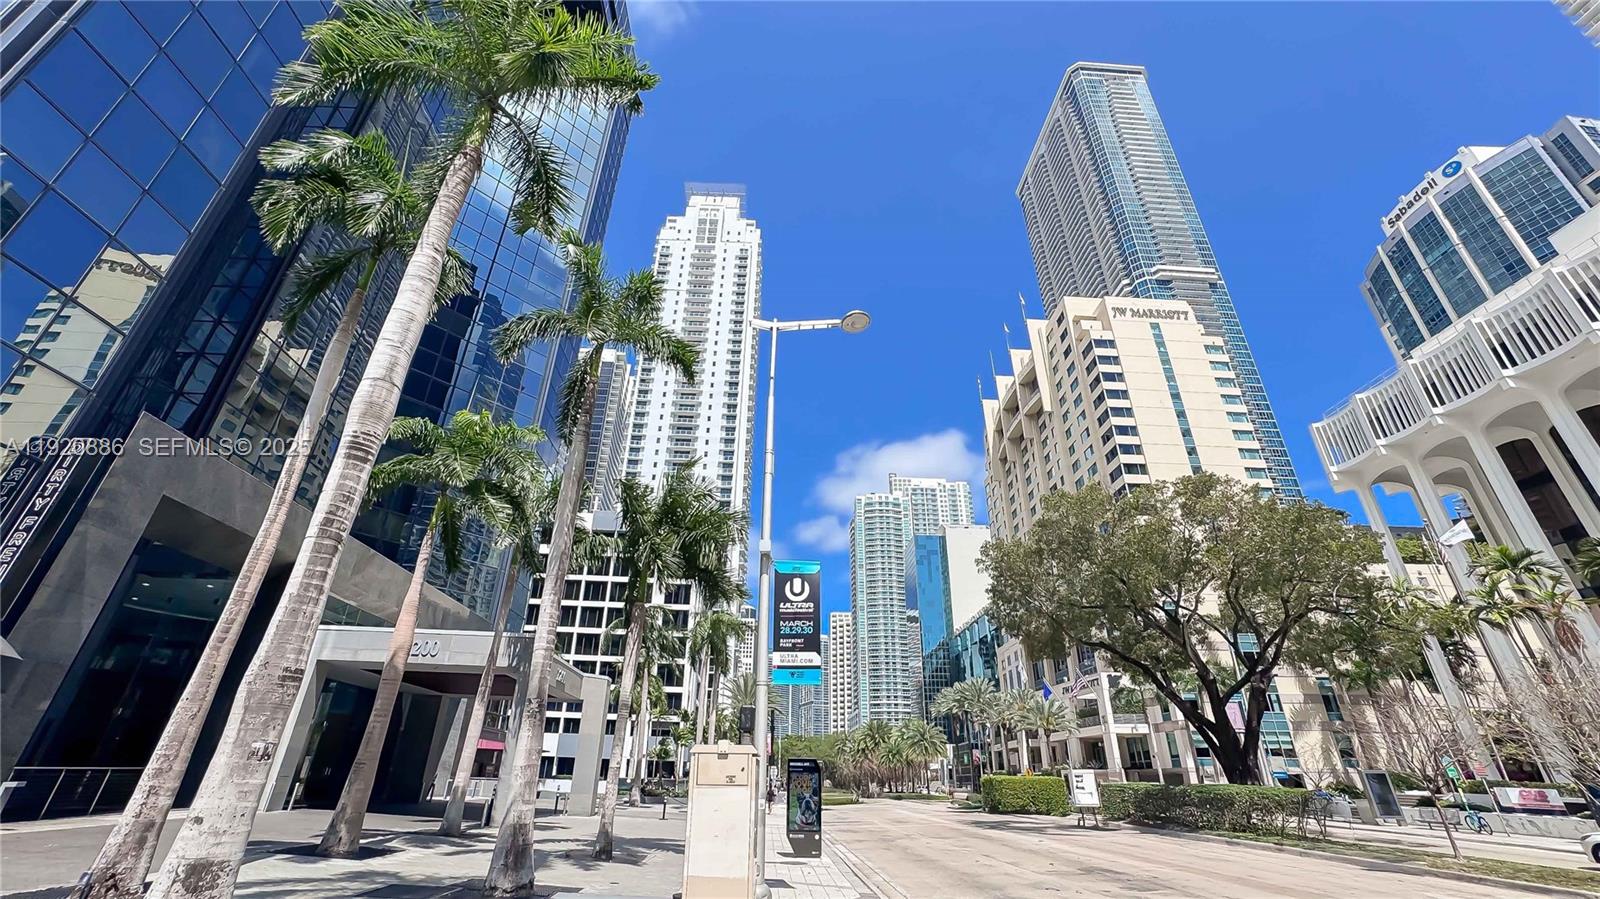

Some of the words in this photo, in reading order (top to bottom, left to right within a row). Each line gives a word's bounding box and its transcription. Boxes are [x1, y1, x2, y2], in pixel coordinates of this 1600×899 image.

[1387, 178, 1438, 229] Sabadell
[1111, 306, 1128, 319] JW
[1129, 307, 1189, 321] MARRIOTT
